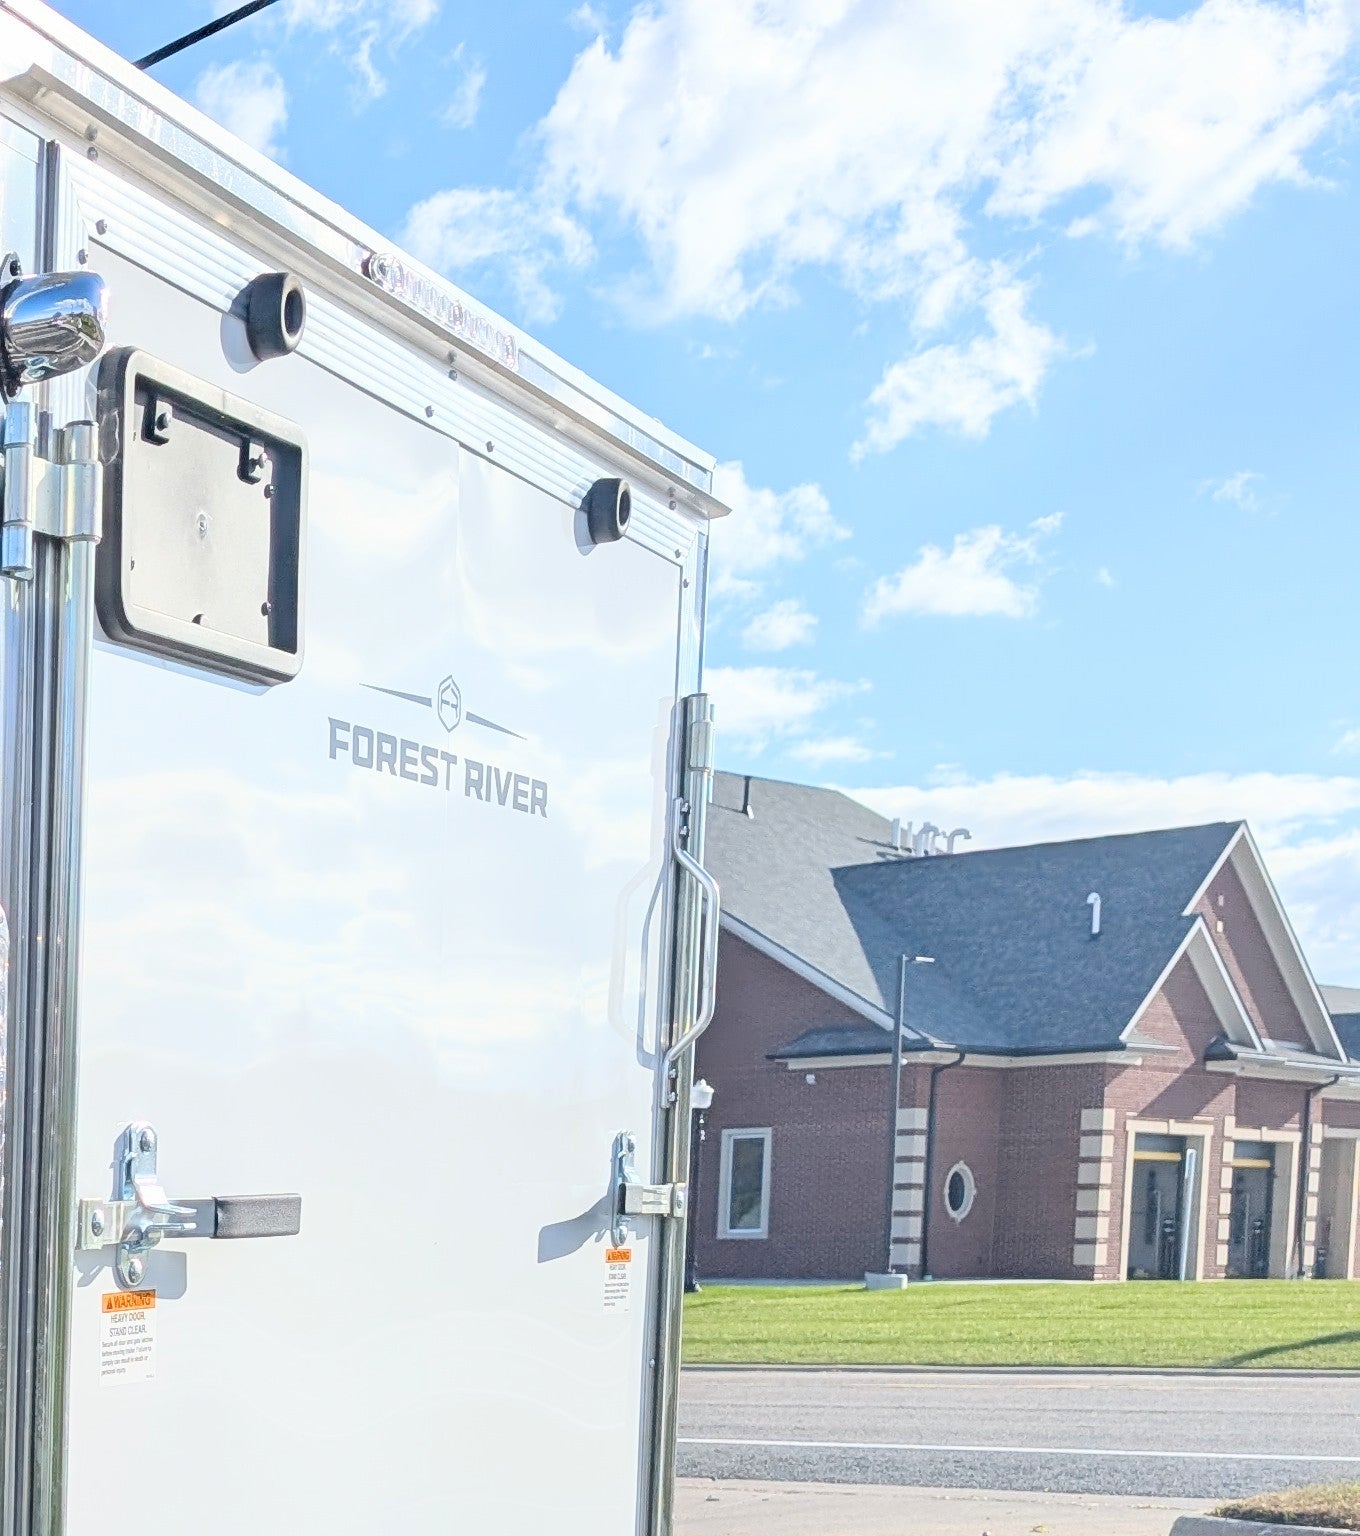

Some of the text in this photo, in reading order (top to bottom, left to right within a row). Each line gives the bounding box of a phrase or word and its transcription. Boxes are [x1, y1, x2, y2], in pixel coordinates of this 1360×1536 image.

[328, 716, 548, 818] FOREST RIVER
[114, 1292, 151, 1308] WARNING
[129, 1311, 145, 1321] DOOR
[110, 1324, 147, 1337] STAND CLEAR
